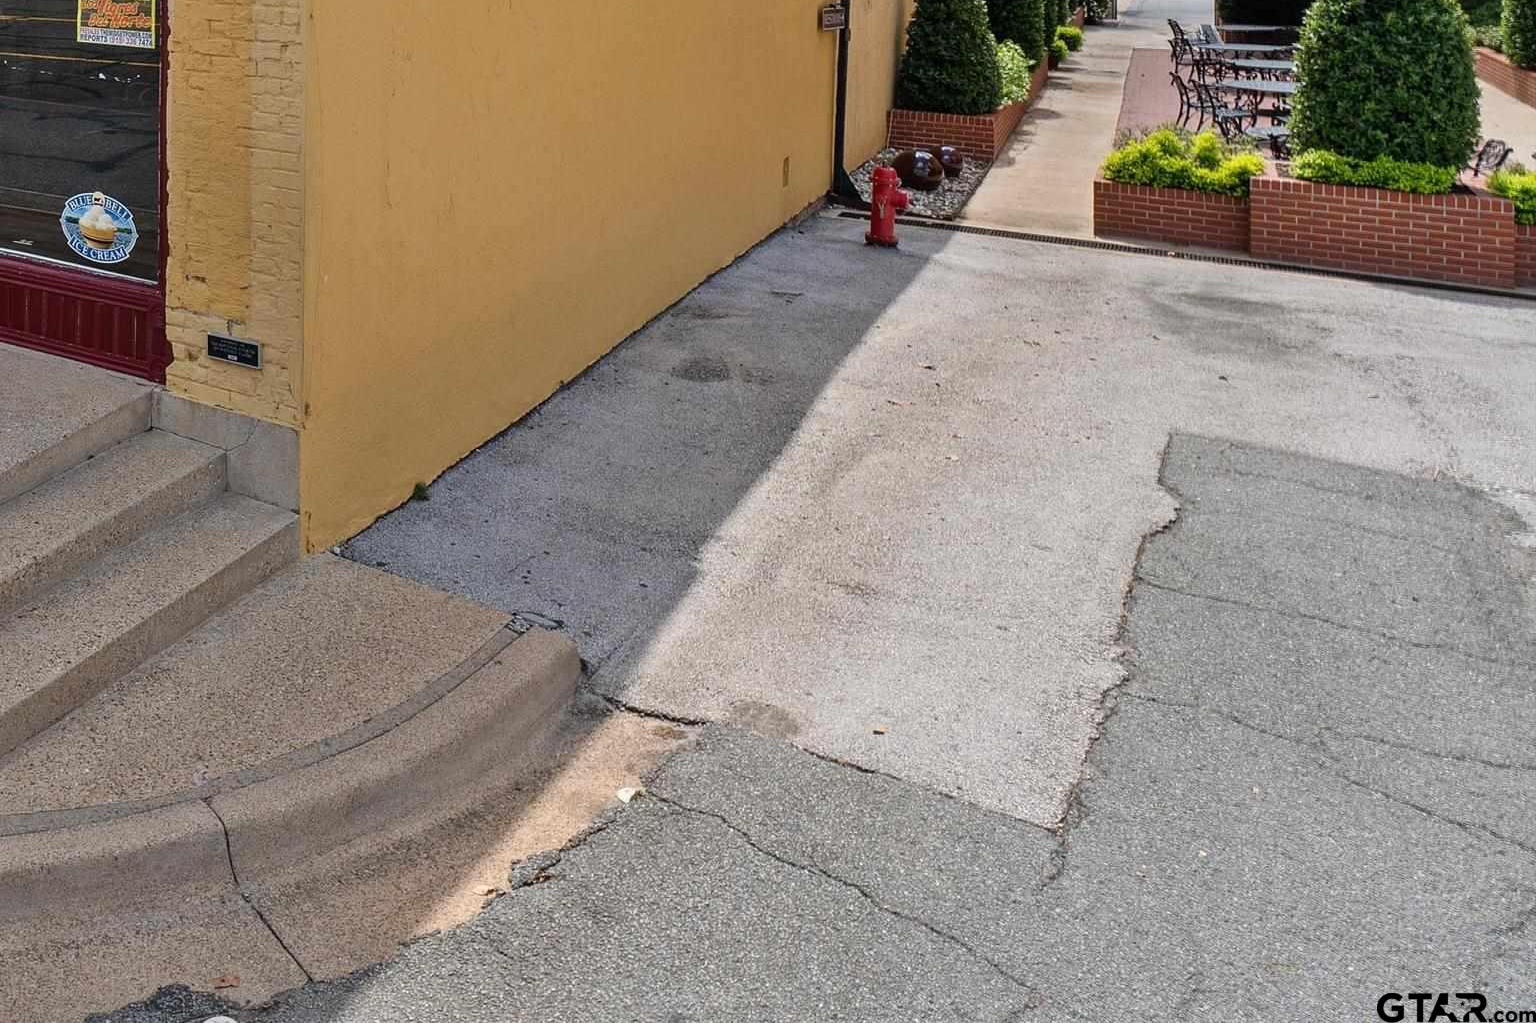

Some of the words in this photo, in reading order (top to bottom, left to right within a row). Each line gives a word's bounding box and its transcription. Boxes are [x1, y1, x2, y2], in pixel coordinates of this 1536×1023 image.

[69, 195, 93, 210] BLUE
[105, 199, 128, 219] BELL
[72, 239, 89, 256] ICE
[90, 247, 126, 261] CREAM
